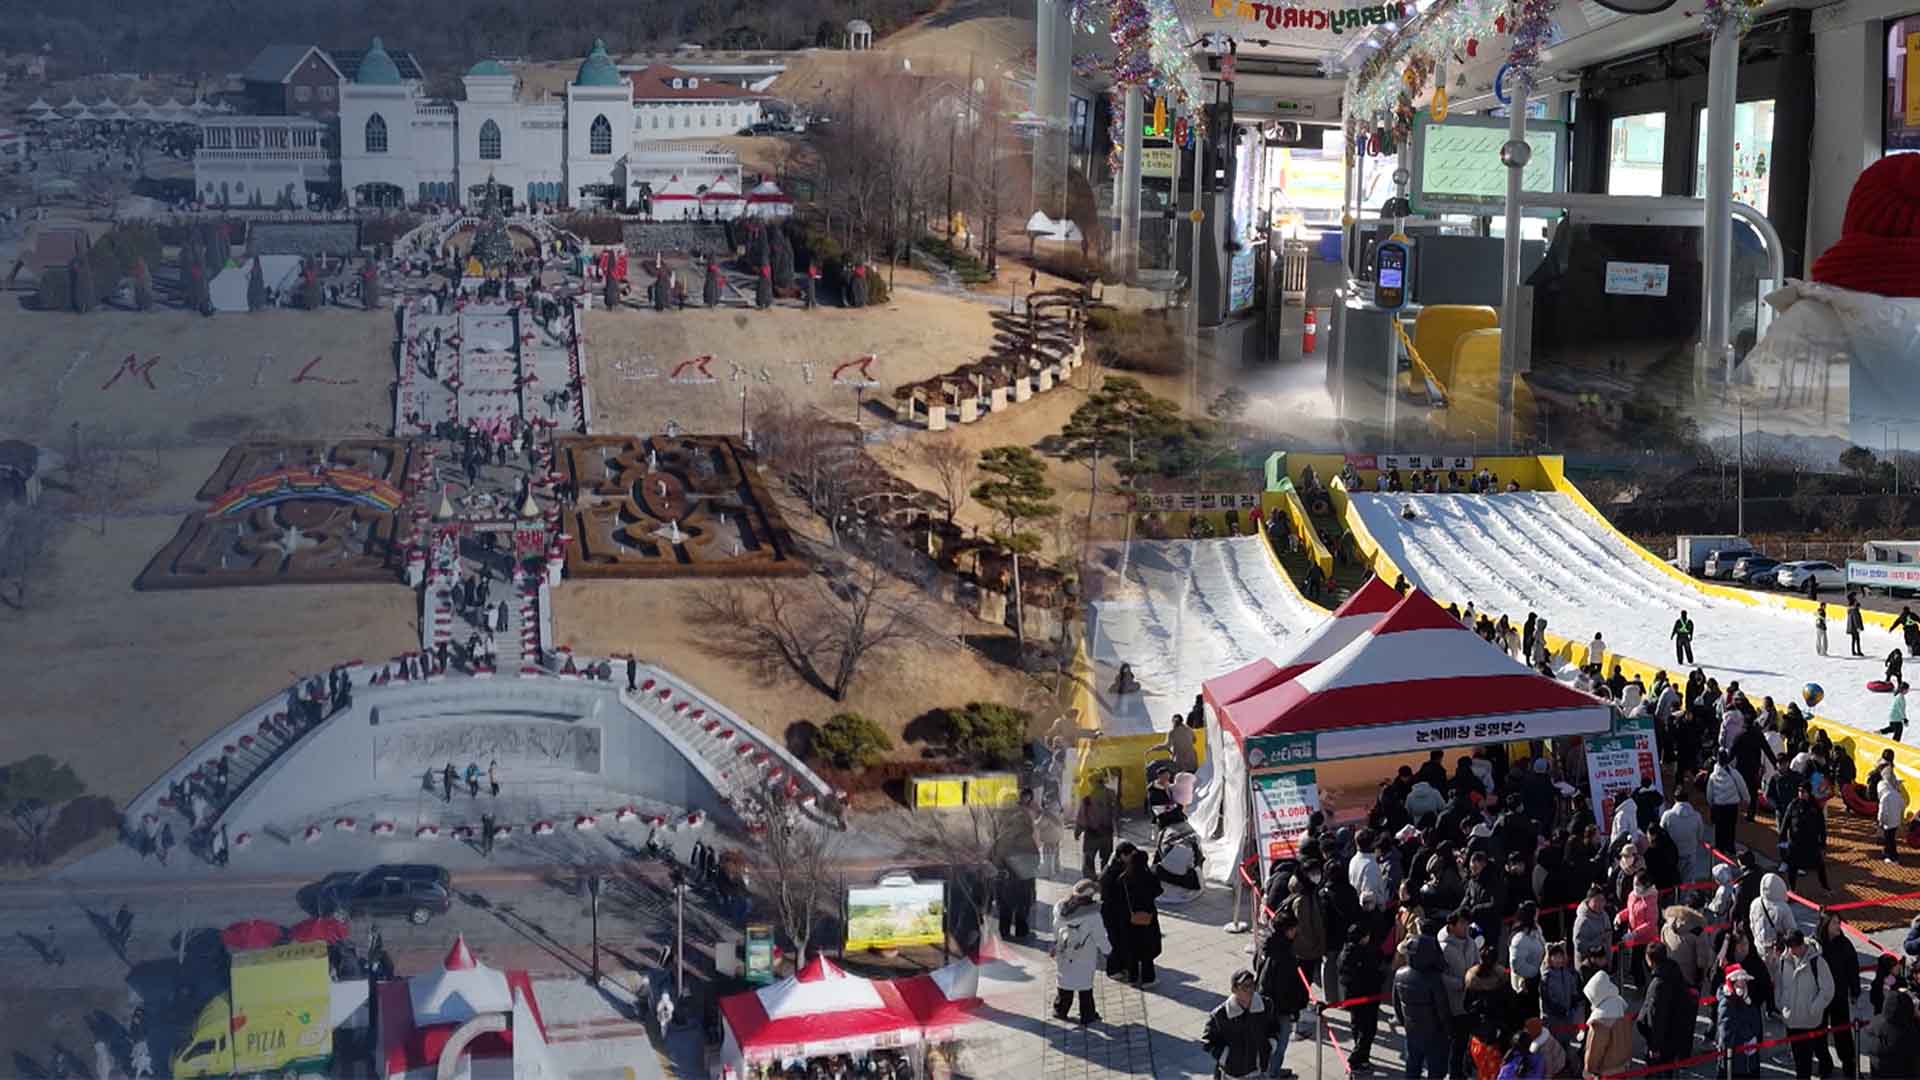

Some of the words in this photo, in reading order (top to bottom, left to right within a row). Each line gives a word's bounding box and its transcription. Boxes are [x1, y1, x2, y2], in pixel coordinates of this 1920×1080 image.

[1416, 725, 1470, 742] 눈썰매장
[1474, 720, 1526, 737] 운영부스
[247, 1029, 286, 1053] PIZZA
